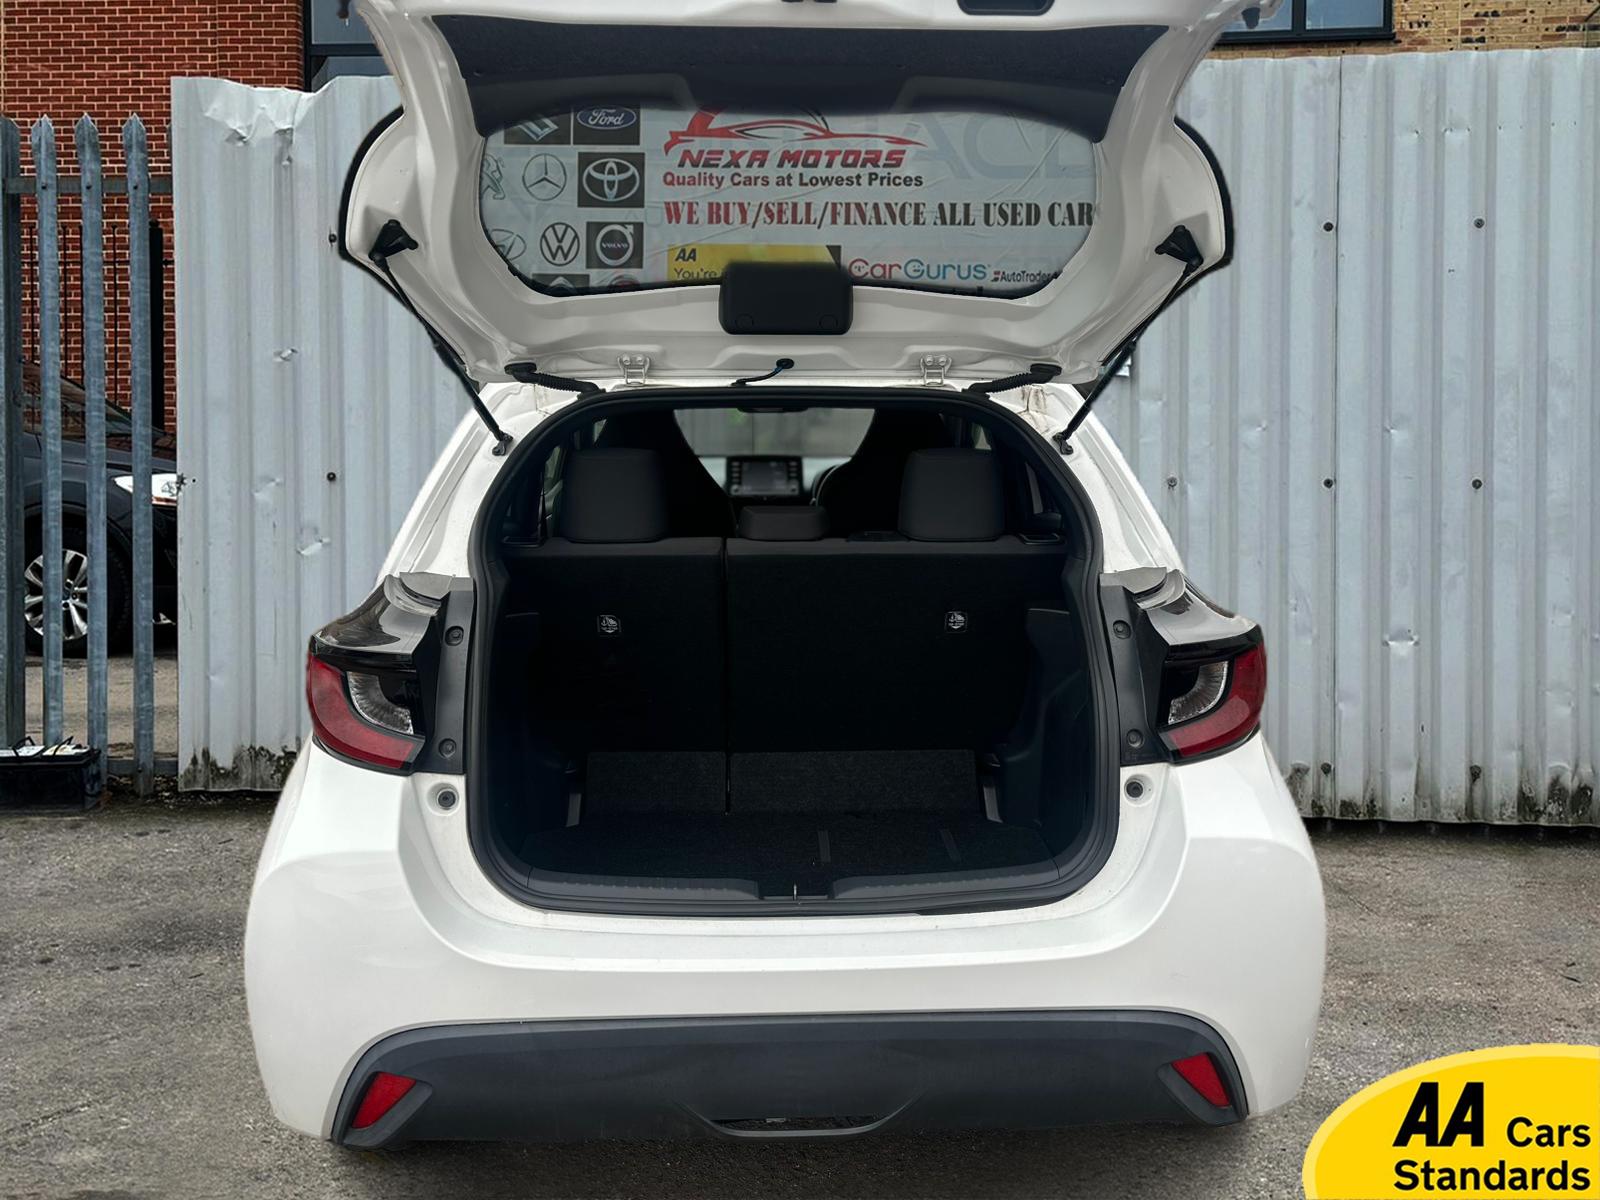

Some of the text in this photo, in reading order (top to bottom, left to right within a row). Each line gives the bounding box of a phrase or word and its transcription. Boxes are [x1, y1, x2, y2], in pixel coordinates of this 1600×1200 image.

[588, 108, 625, 125] Ford
[678, 149, 906, 168] NEXA MOTORS
[663, 172, 924, 189] Quality Cars at Lowest Prices
[664, 201, 700, 225] WE
[706, 201, 926, 229] BUY/SELL/FINANCE
[932, 202, 976, 226] ALL
[983, 202, 1042, 227] USED
[675, 248, 697, 262] AA
[674, 267, 718, 280] You're
[849, 258, 987, 281] CarGurus
